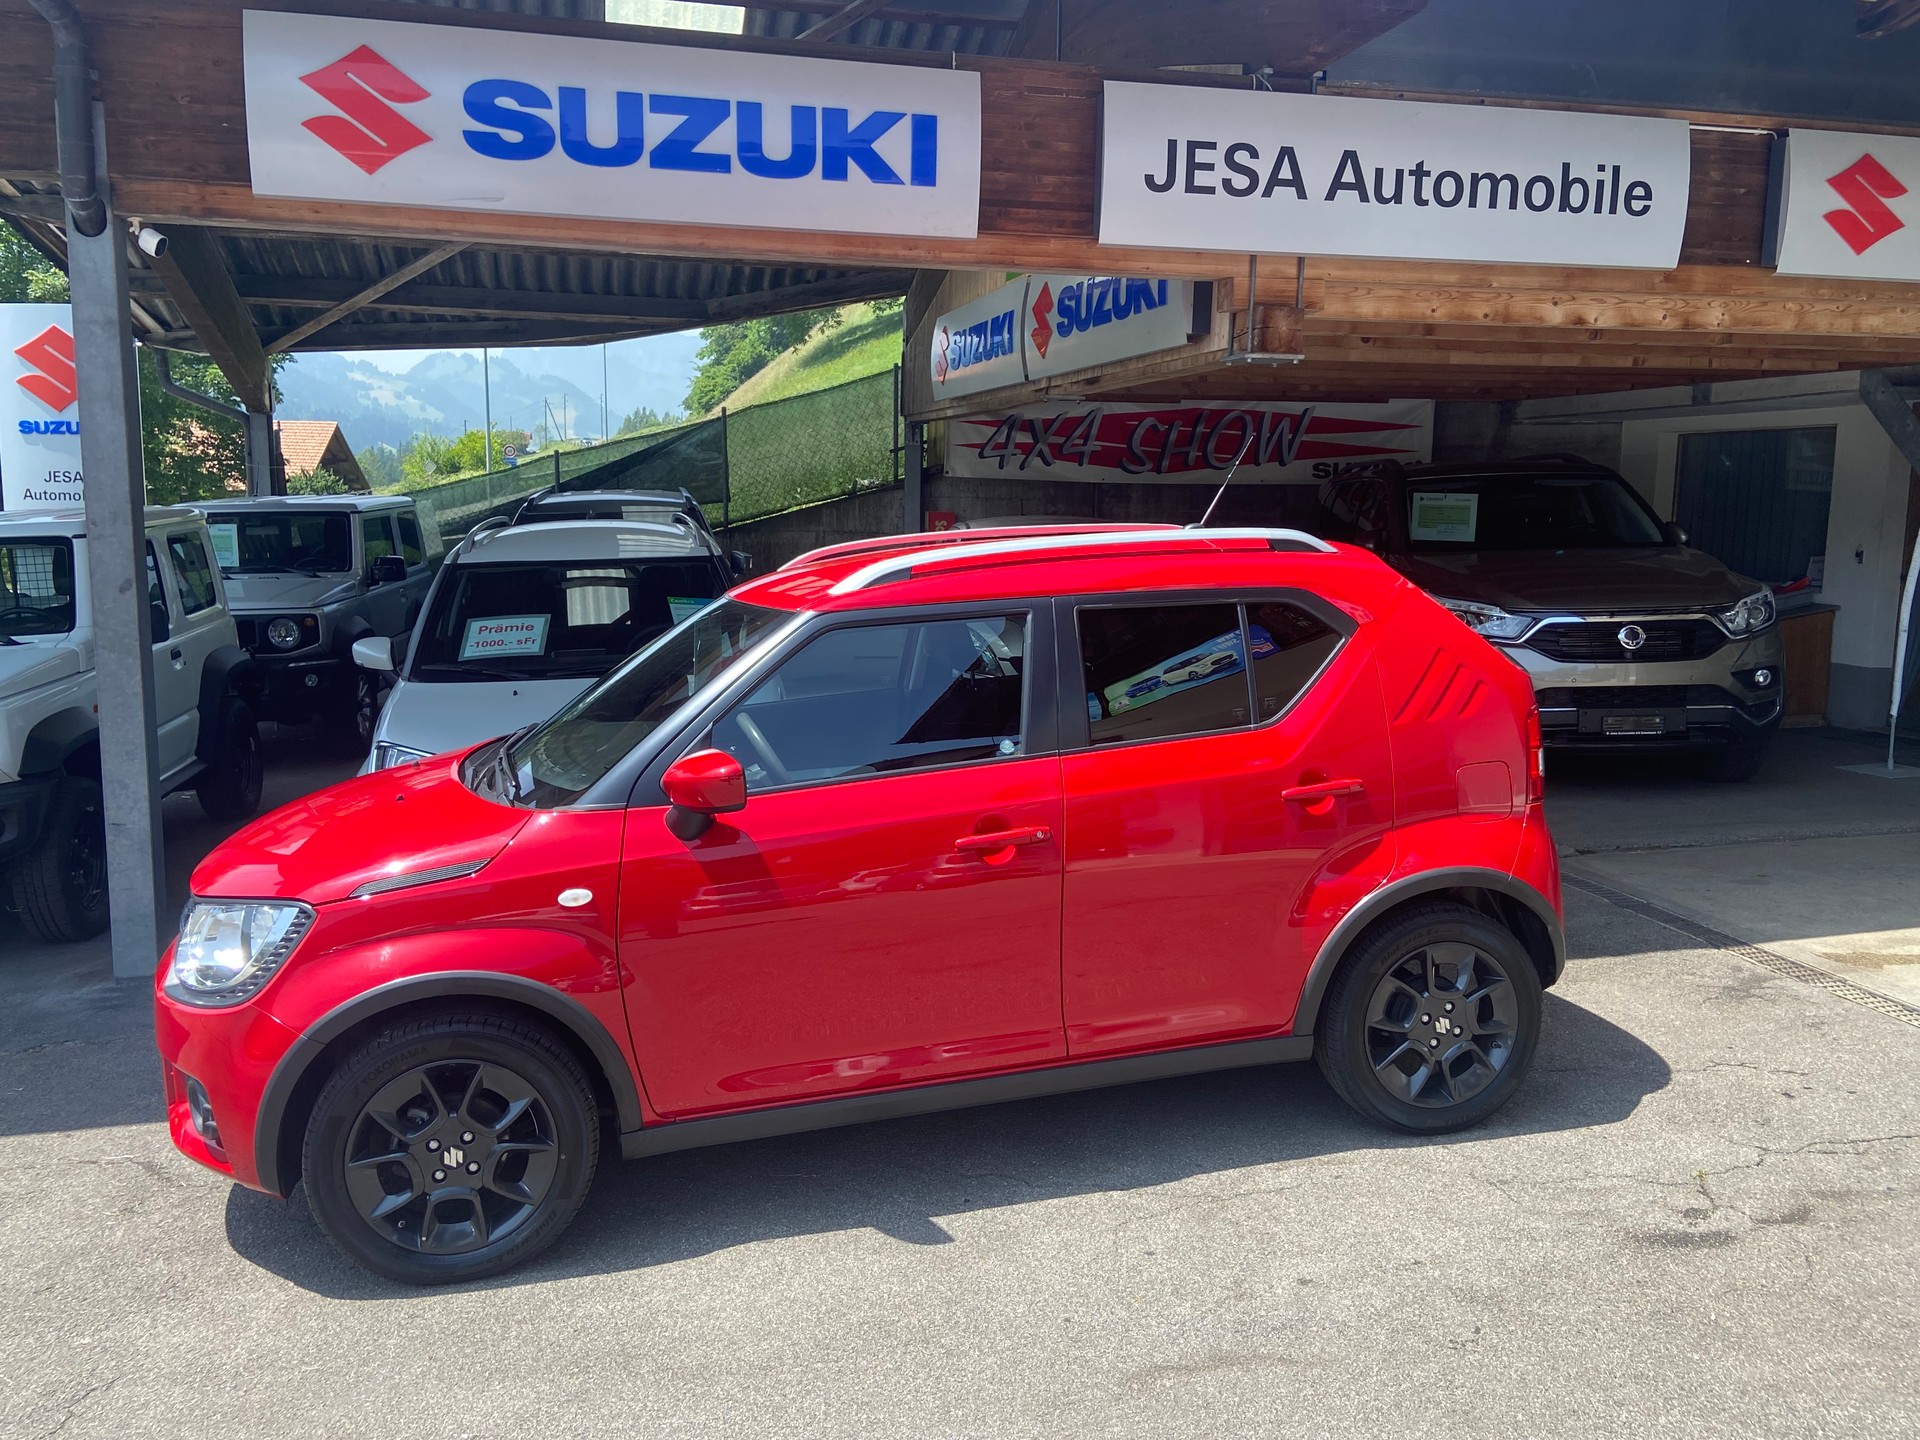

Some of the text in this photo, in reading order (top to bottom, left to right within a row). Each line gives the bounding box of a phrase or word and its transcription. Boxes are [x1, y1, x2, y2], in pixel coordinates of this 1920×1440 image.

[462, 78, 938, 187] SUZUKI
[1144, 139, 1653, 217] JESA Automobile
[950, 310, 1015, 370] SUZUKI
[1119, 404, 1318, 476] SHOW
[23, 488, 84, 502] Automo
[44, 470, 84, 484] JESA
[478, 623, 535, 635] Prämie
[516, 637, 537, 646] sFr
[361, 1045, 429, 1085] YOKOHAMA
